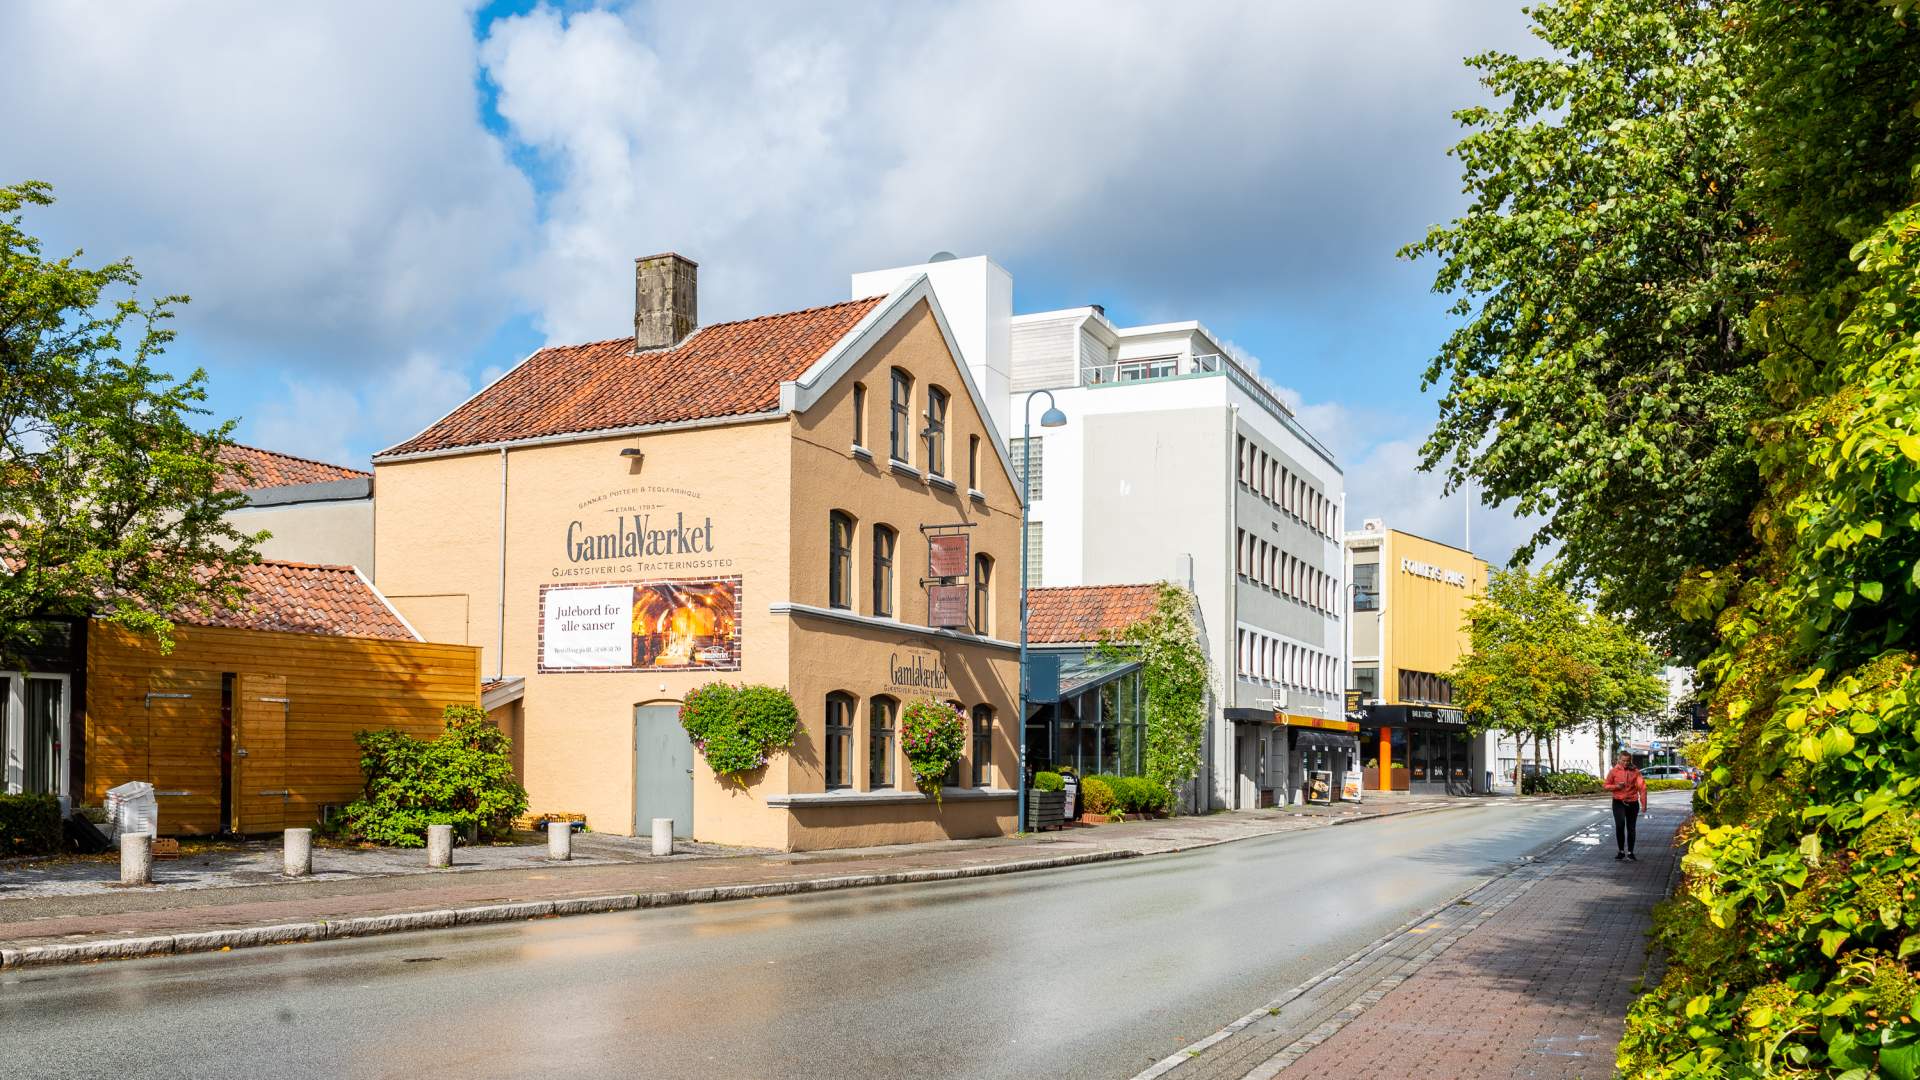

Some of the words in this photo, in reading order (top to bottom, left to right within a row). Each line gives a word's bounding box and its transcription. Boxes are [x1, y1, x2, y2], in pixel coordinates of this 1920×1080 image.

[567, 512, 714, 563] GamlaVærket
[620, 565, 633, 573] OG
[637, 559, 733, 572] TRACTERINGSSTED
[554, 604, 601, 620] Julebord
[605, 604, 621, 616] for
[561, 620, 580, 632] alle
[582, 621, 616, 631] sanser
[890, 652, 949, 690] GamlaVærket
